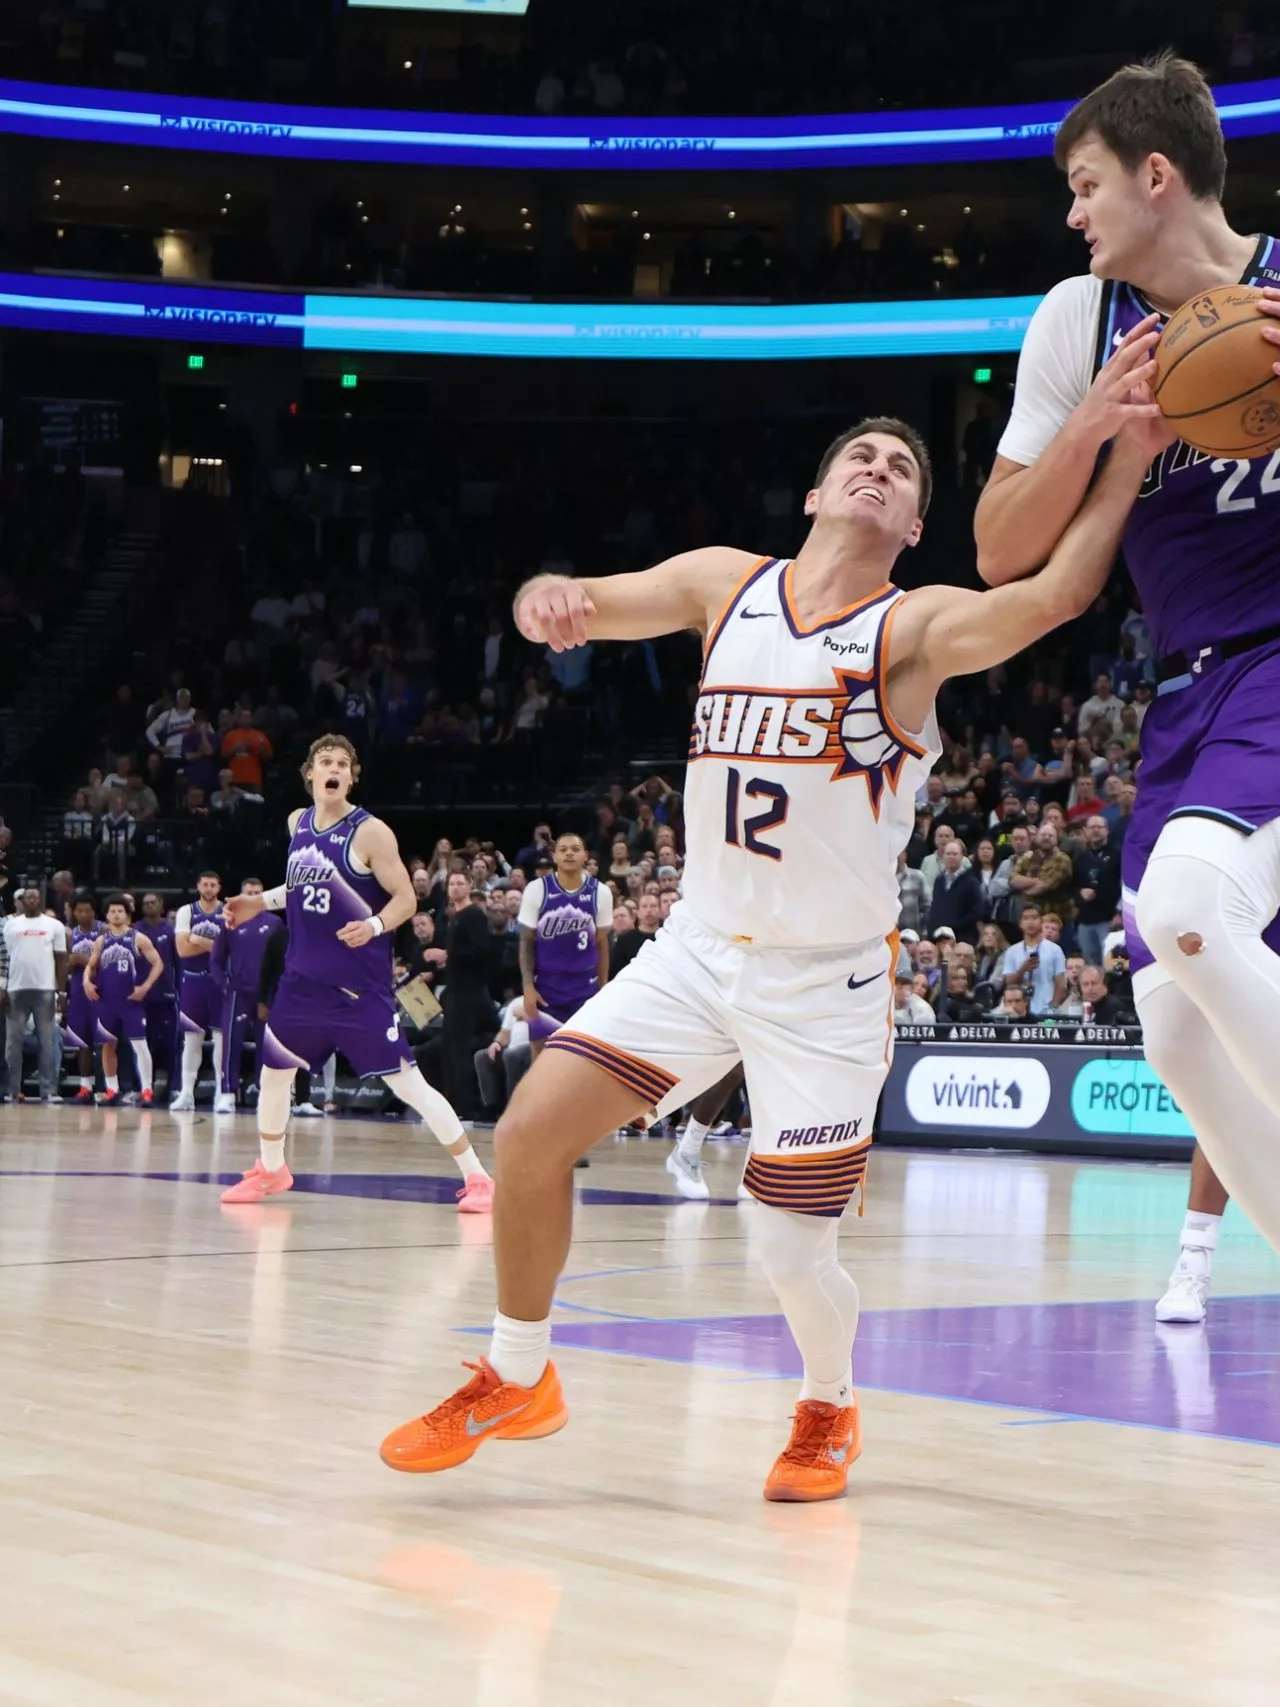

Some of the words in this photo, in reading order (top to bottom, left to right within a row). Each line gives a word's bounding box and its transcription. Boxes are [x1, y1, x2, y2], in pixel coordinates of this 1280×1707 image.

[186, 118, 293, 138] visionary
[614, 137, 716, 151] visionary
[170, 306, 278, 328] visionary
[823, 636, 869, 656] PayPal
[695, 693, 834, 757] SUNS
[725, 766, 790, 862] 12
[286, 860, 334, 892] UTAH
[303, 884, 331, 915] 23
[542, 916, 593, 939] UTAH
[577, 930, 589, 951] 3
[900, 1026, 936, 1038] DELTA
[960, 1027, 997, 1039] DELTA
[1022, 1027, 1061, 1040] DELTA
[1087, 1028, 1127, 1042] DELTA
[933, 1073, 1001, 1109] vivint
[777, 1117, 863, 1149] PHOENIX
